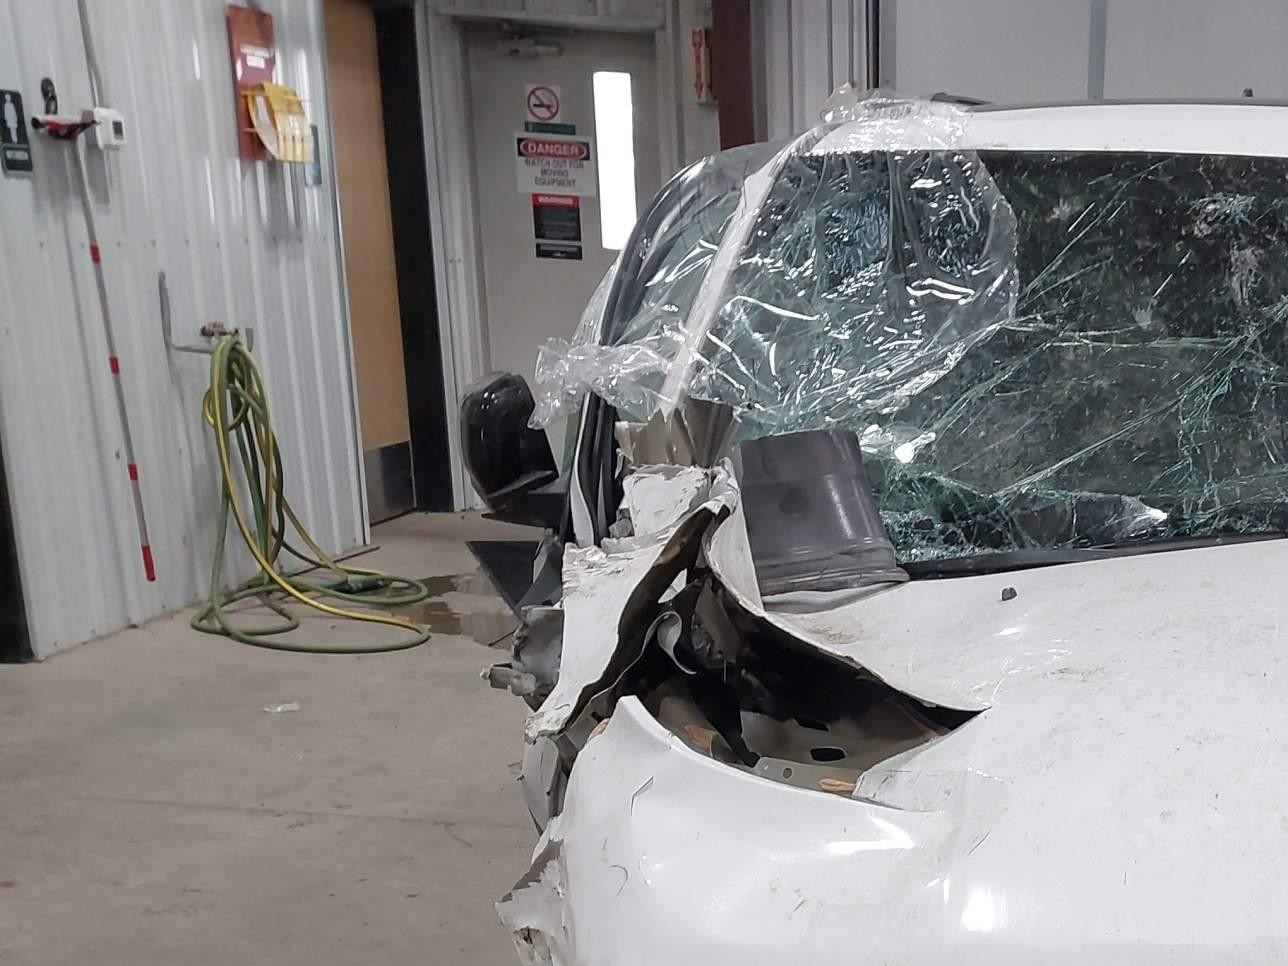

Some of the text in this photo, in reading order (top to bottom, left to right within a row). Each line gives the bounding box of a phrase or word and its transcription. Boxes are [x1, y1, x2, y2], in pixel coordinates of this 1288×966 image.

[527, 142, 579, 156] DANGER
[524, 158, 584, 170] WATCH OUT FOR
[540, 168, 569, 177] MOVING
[534, 176, 576, 188] EQUIPMENT
